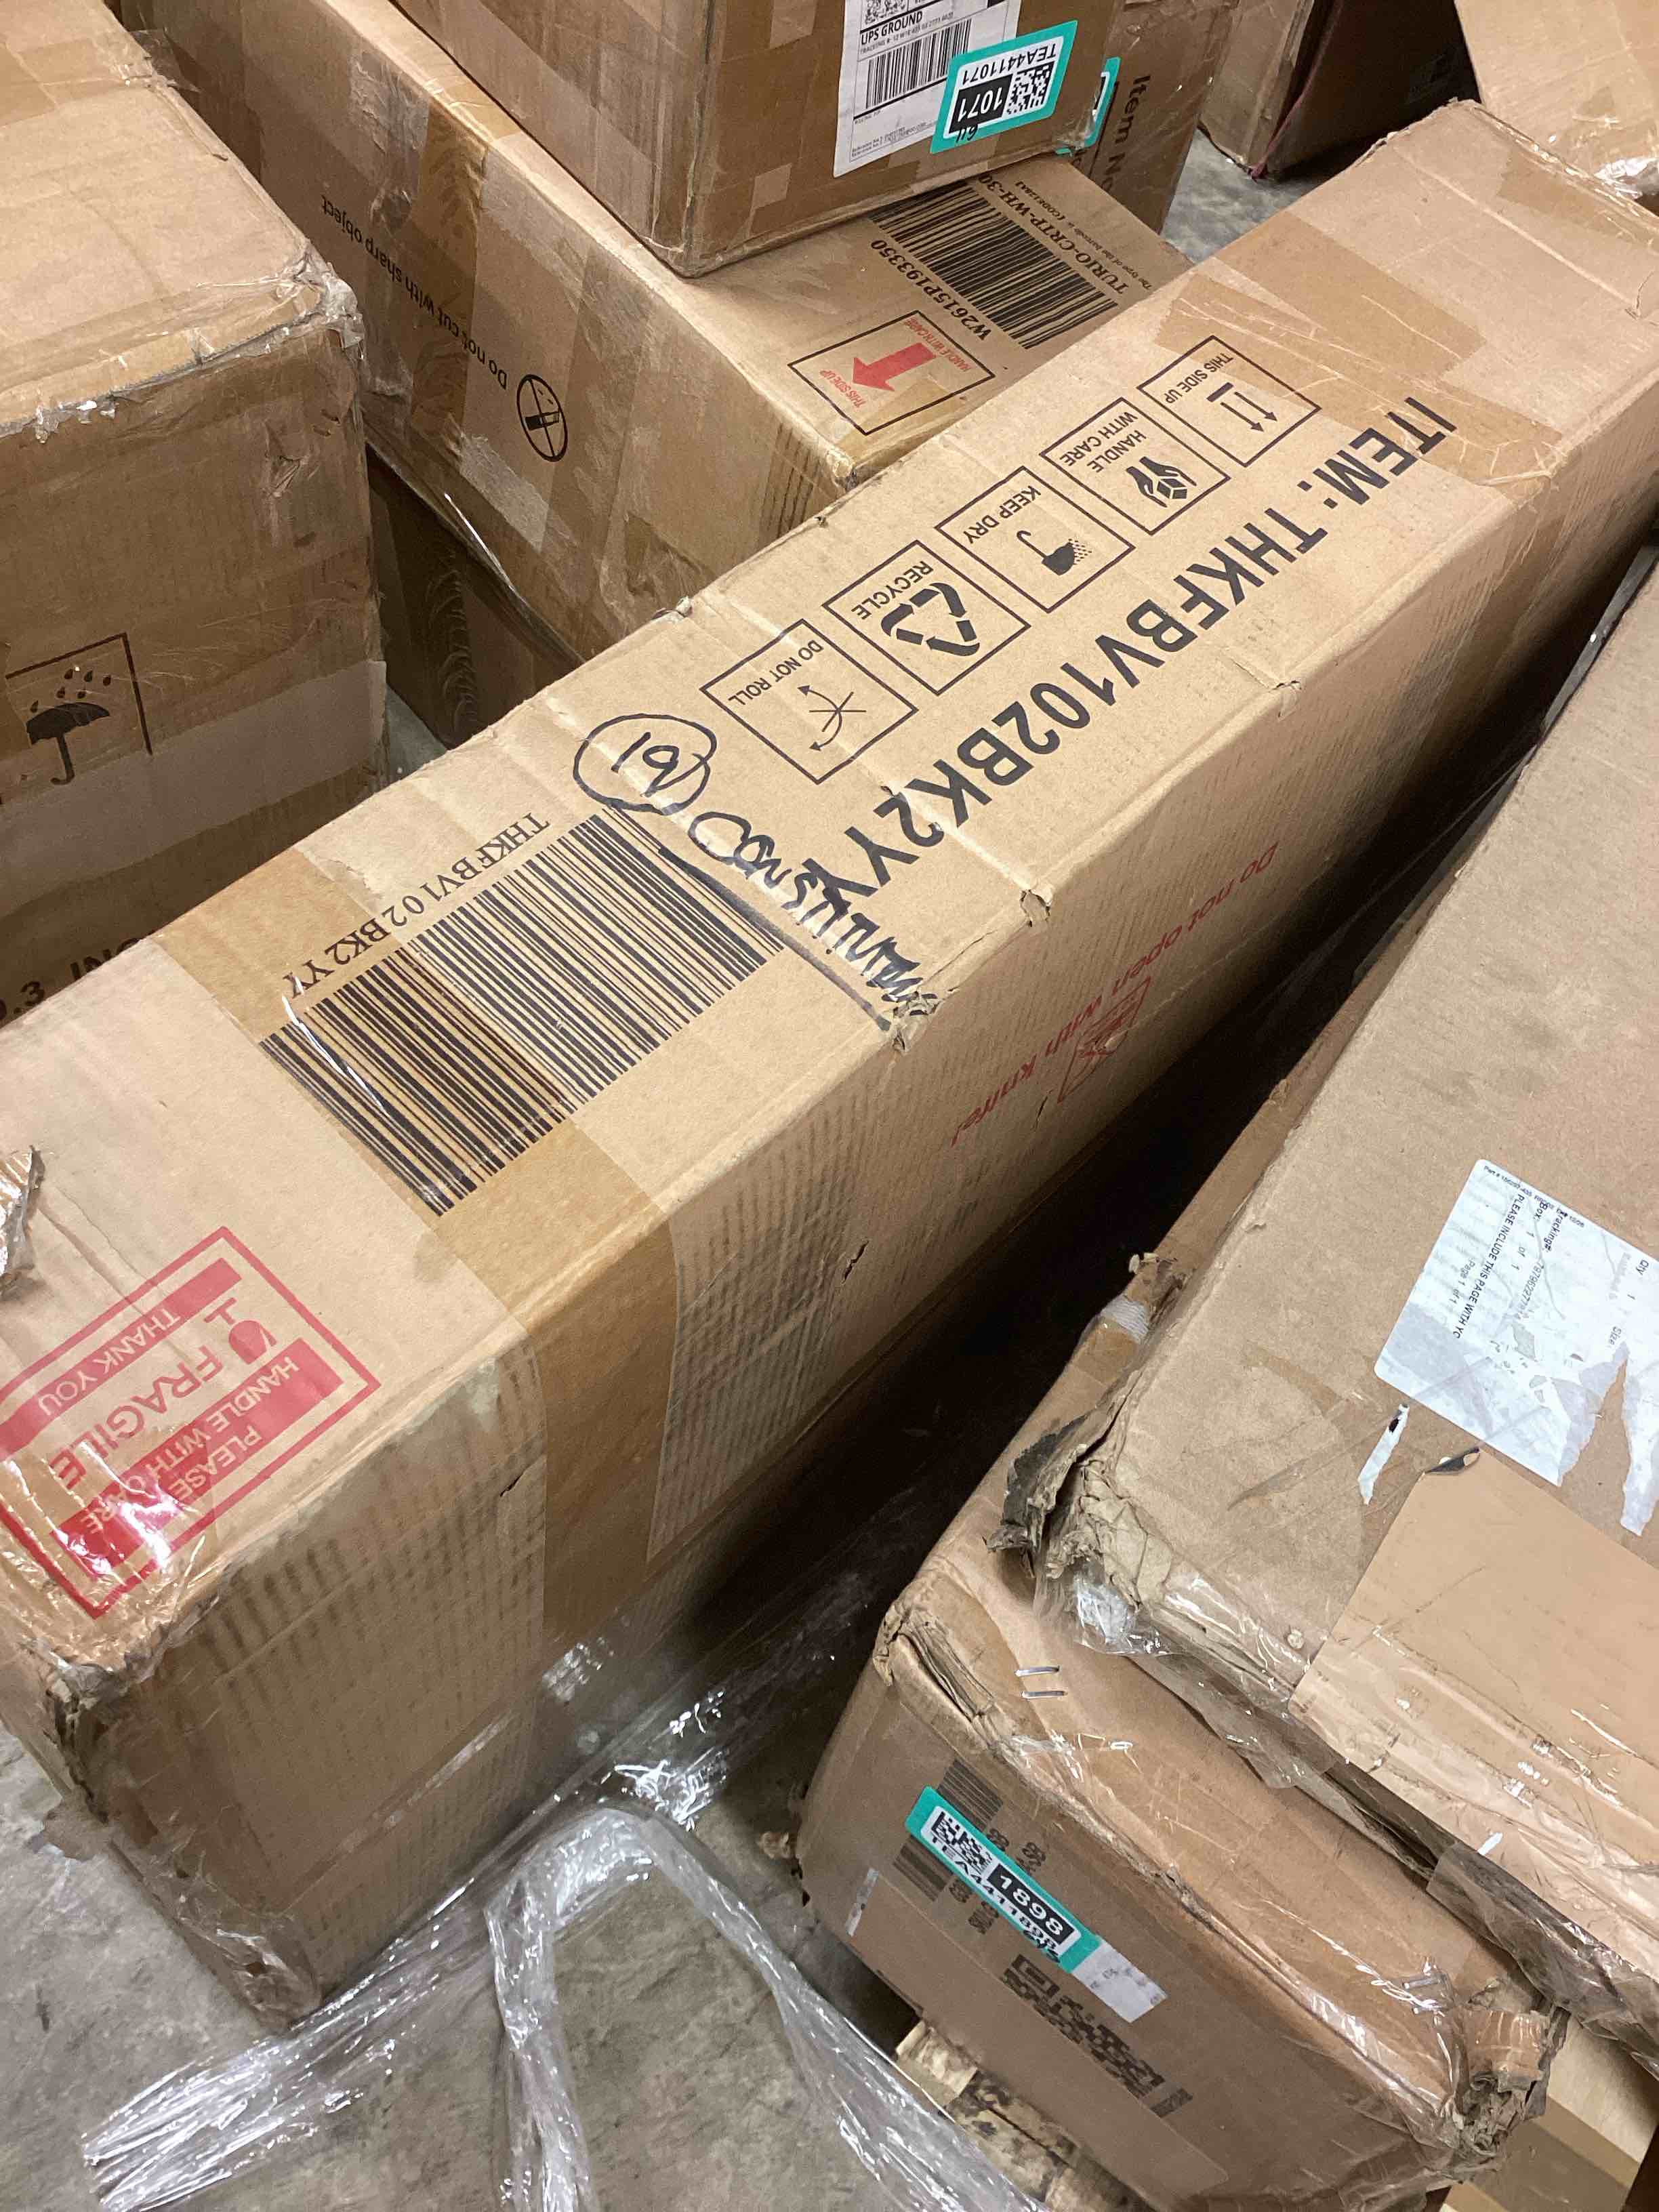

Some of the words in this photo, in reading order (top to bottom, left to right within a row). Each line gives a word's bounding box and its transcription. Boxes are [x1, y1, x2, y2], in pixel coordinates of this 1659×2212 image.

[861, 29, 879, 45] UPS
[881, 11, 922, 37] GROUND
[962, 43, 1056, 85] TEA4411071
[958, 87, 1002, 122] 1071
[1115, 75, 1150, 144] Item
[322, 194, 362, 243] object
[365, 238, 402, 283] sharp
[406, 276, 434, 315] with
[869, 237, 992, 341] W2615P193350
[438, 306, 459, 337] cut
[462, 331, 485, 364] not
[1205, 352, 1233, 375] THIS
[489, 360, 506, 390] Do
[819, 369, 837, 383] UP
[1181, 366, 1208, 393] SIDE
[1164, 387, 1183, 405] UP
[1093, 411, 1136, 447] WITH
[1061, 435, 1098, 468] CARE
[1087, 430, 1147, 474] HANDLE
[1298, 397, 1457, 510] ITEM:
[998, 485, 1042, 518] KEEP
[963, 514, 1001, 544] DRY
[851, 560, 935, 620] RECYCLE
[766, 655, 802, 683] NOT
[796, 640, 824, 662] DO
[729, 676, 768, 705] ROLL
[801, 508, 1328, 915] THKFBV102BK2YY
[1240, 841, 1279, 883] Do
[1188, 879, 1235, 933] not
[1111, 924, 1183, 996] open
[1045, 995, 1102, 1057] with
[1504, 1193, 1525, 1226] PLEASE
[1488, 1225, 1511, 1261] INCLUDE
[1460, 1259, 1475, 1279] Page
[1480, 1261, 1494, 1279] THIS
[1635, 1259, 1650, 1275] Qty
[1469, 1279, 1485, 1304] PAGE
[1458, 1303, 1475, 1326] WITH
[94, 1305, 182, 1374] THANK
[37, 1369, 98, 1418] YOU
[205, 1356, 300, 1432] HANDLE
[47, 1345, 224, 1490] FRAGILE
[145, 1425, 211, 1477] WITH
[167, 1426, 263, 1500] PLEASE
[931, 1834, 1057, 1950] TEA4411898
[998, 1875, 1063, 1936] 1898
